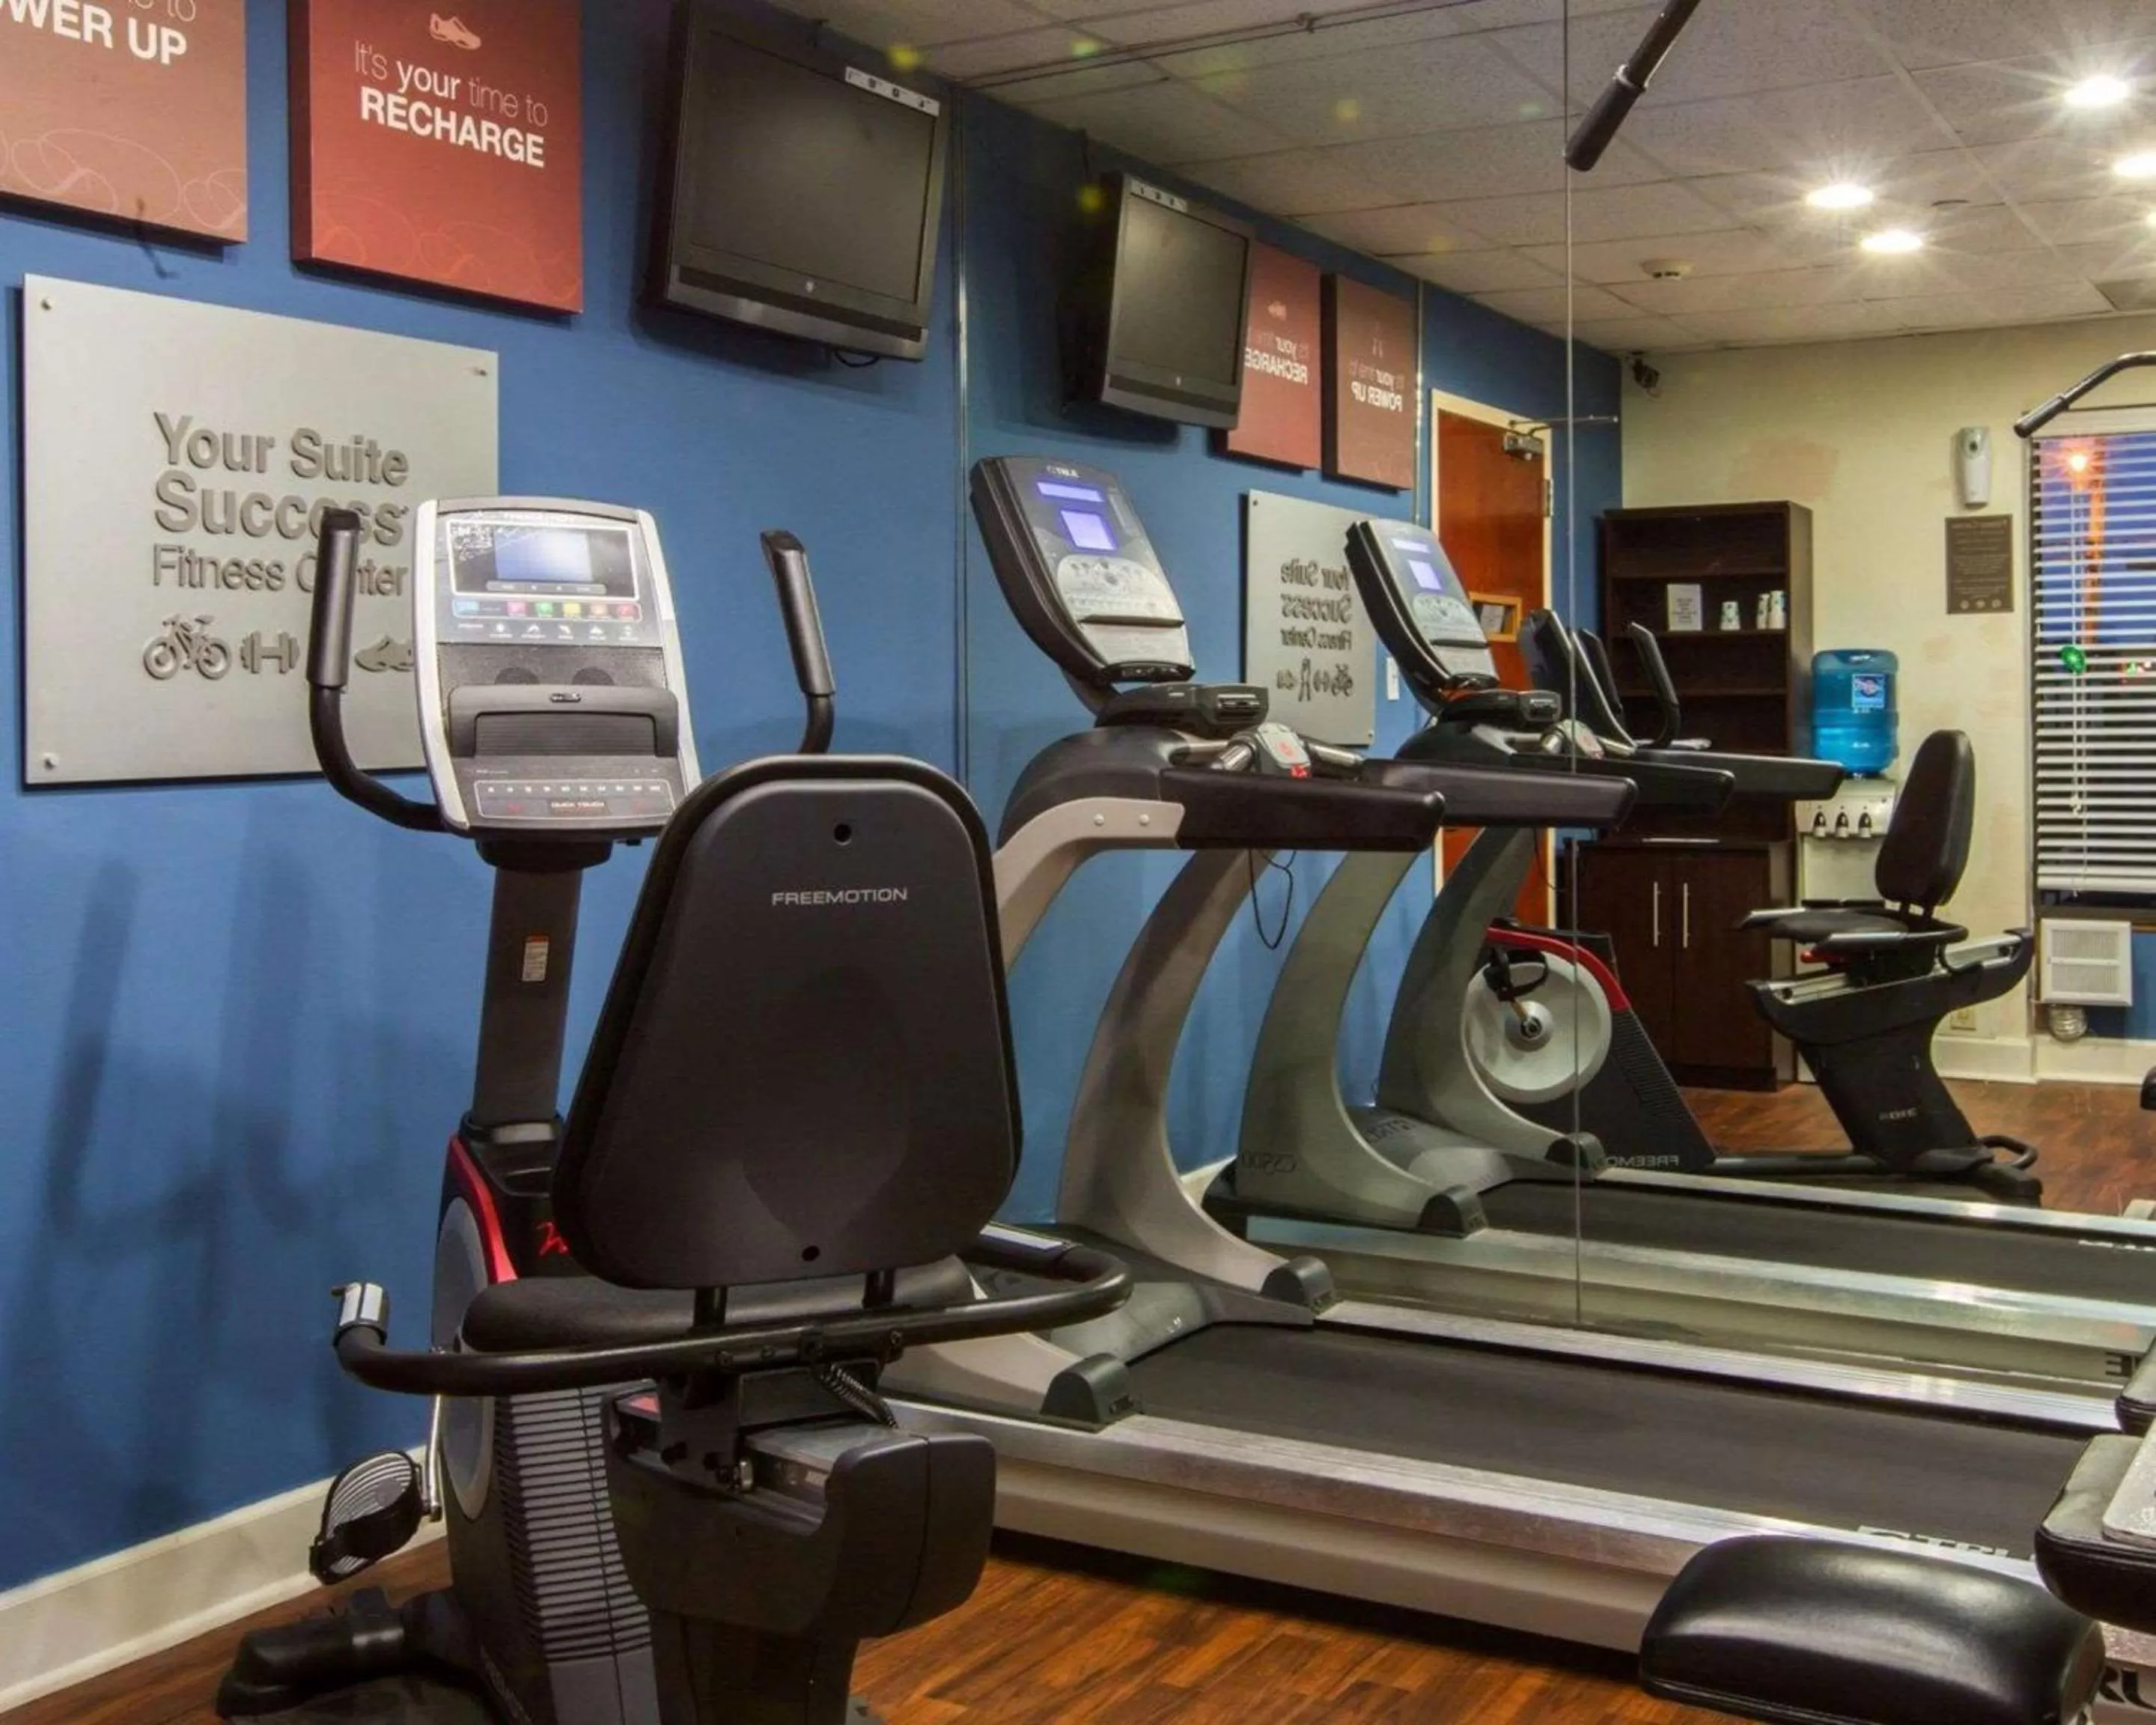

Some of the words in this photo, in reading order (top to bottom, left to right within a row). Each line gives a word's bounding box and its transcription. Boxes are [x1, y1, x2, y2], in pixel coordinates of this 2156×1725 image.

[0, 0, 113, 49] WER
[127, 16, 187, 65] UP
[355, 40, 387, 80] It's
[396, 60, 460, 100] your
[467, 77, 518, 118] time
[525, 94, 548, 127] to
[360, 85, 545, 168] RECHARGE
[153, 411, 275, 475] Your
[290, 428, 409, 486] Suite
[152, 544, 284, 591] Fitness
[296, 552, 409, 597] Cter
[771, 887, 908, 907] FREEMOTION
